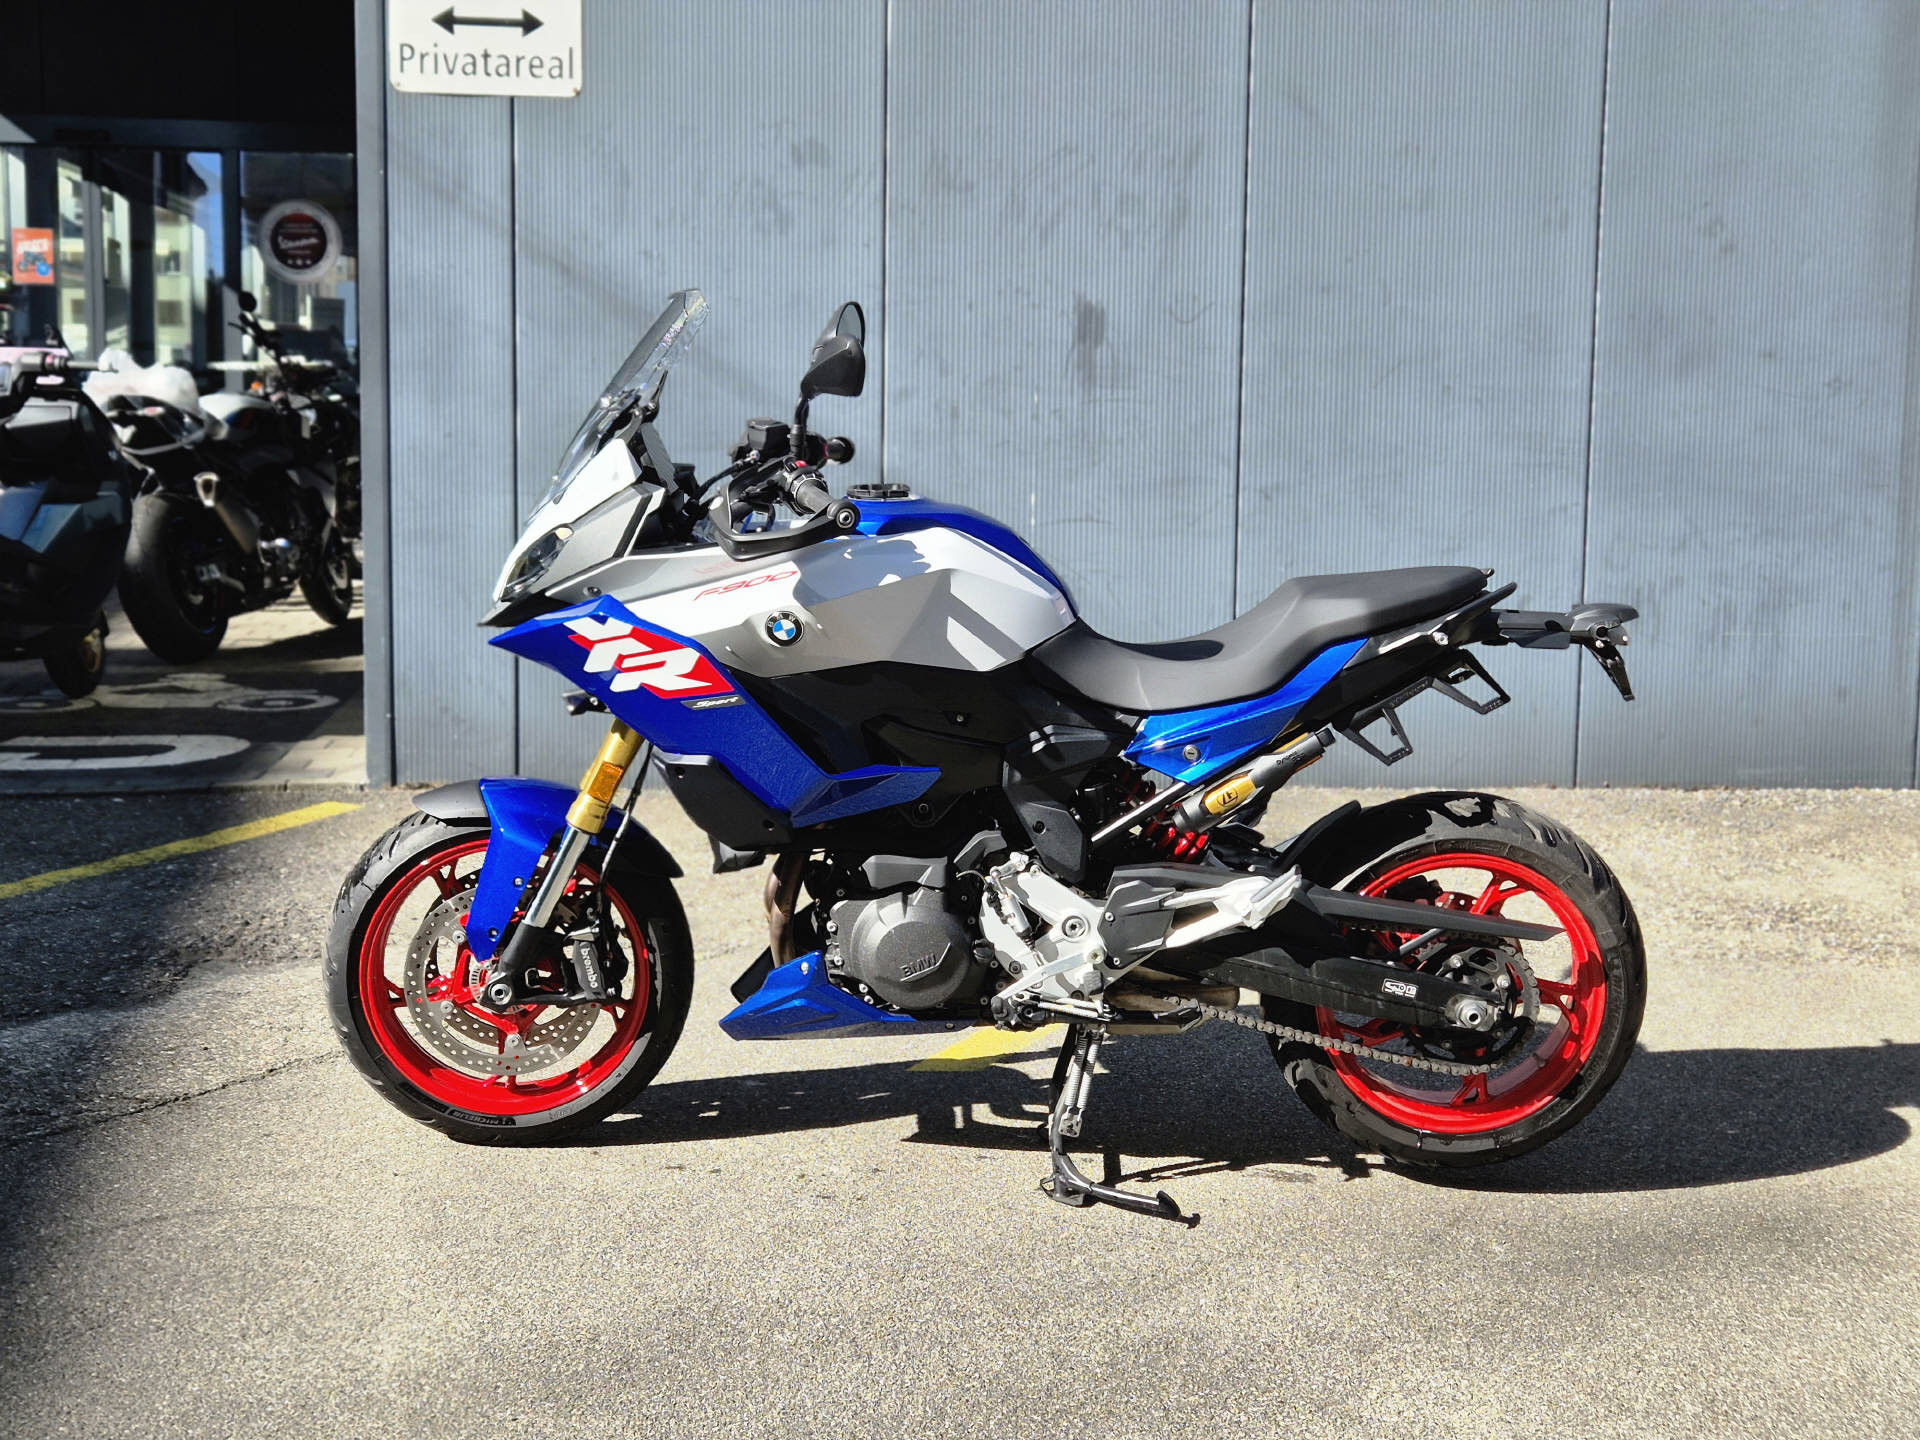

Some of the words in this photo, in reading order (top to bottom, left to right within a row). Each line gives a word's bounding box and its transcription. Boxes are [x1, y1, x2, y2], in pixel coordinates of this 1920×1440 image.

[399, 42, 574, 79] Privatareal
[693, 570, 798, 602] F900
[767, 613, 797, 628] BMW
[563, 616, 712, 693] XR
[692, 695, 739, 708] Sport
[580, 947, 598, 988] brembo
[900, 953, 937, 976] BMW
